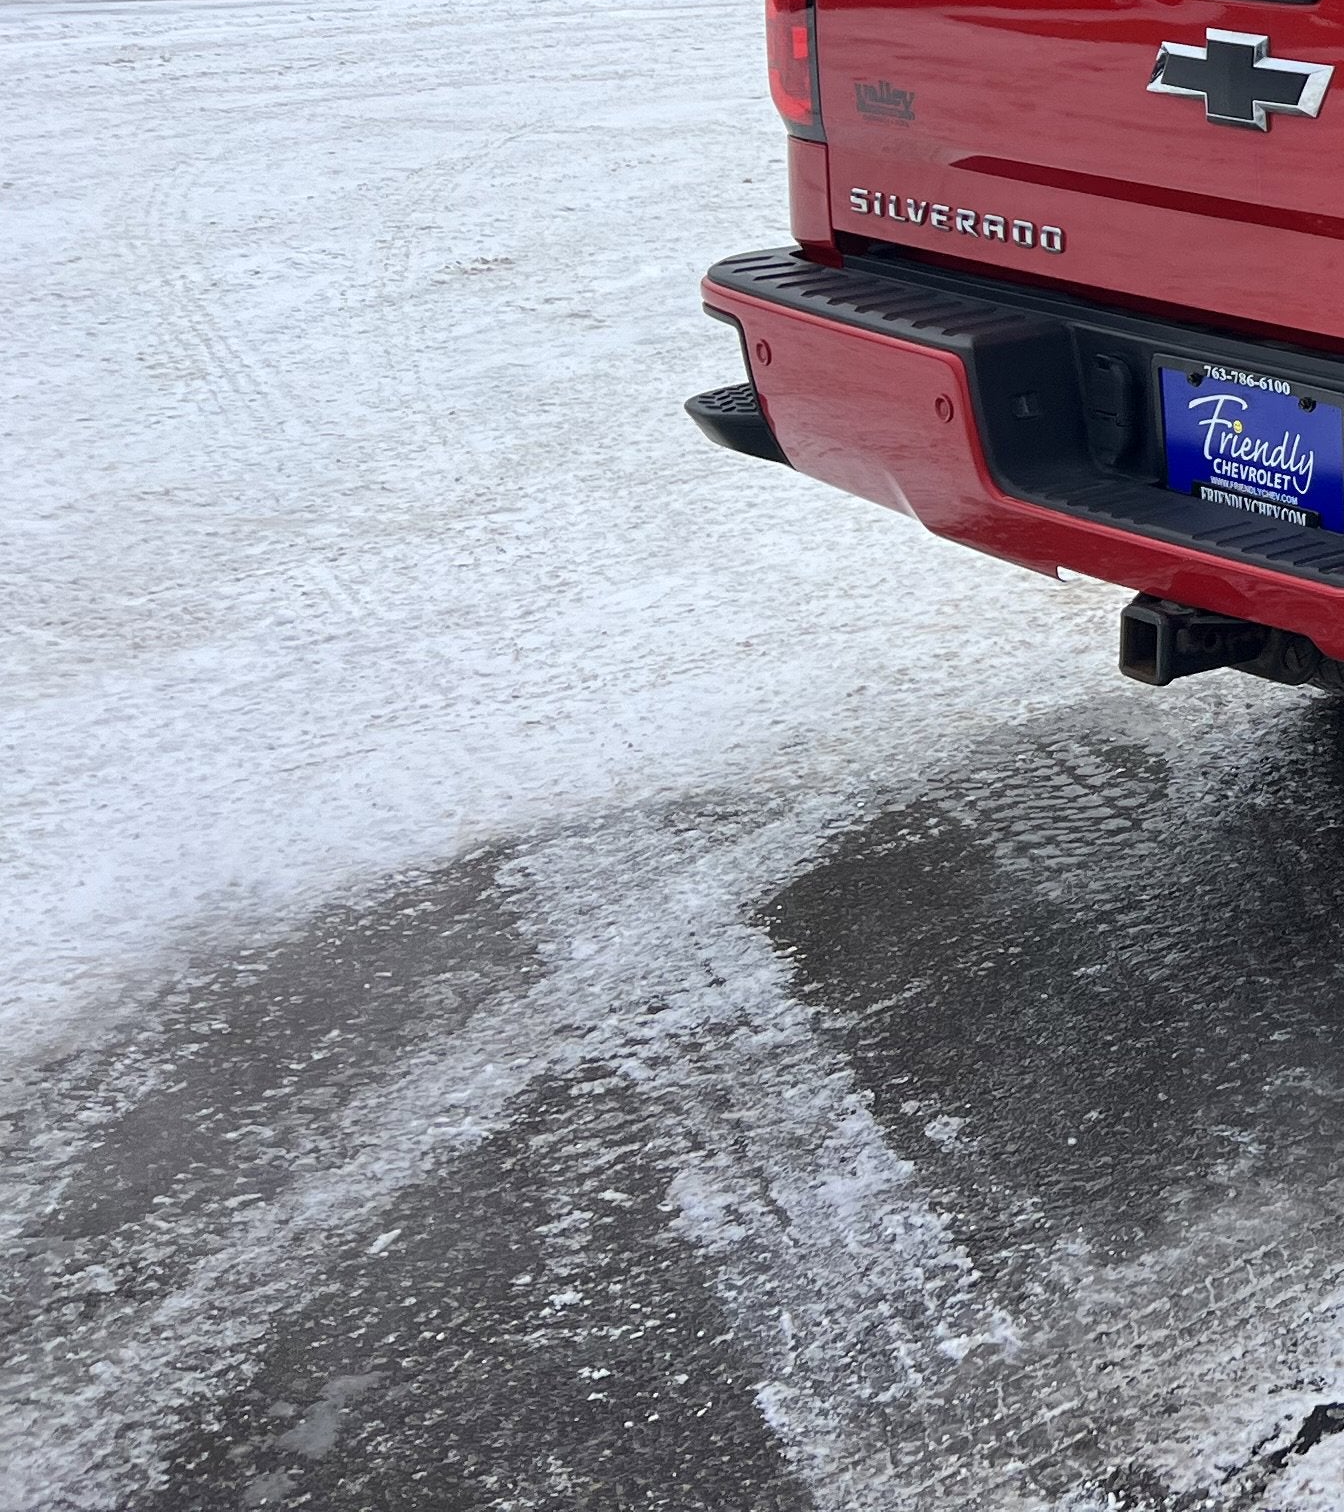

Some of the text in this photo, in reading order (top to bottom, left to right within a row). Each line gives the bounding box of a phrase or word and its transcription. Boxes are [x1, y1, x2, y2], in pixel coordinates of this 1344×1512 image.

[850, 187, 1066, 254] SILVERADO
[1203, 365, 1291, 395] 763-786-6100
[1188, 394, 1314, 494] Friendly
[1213, 457, 1292, 491] CHEVROLET
[1200, 486, 1307, 527] FRIENDLYCHEVCOM
